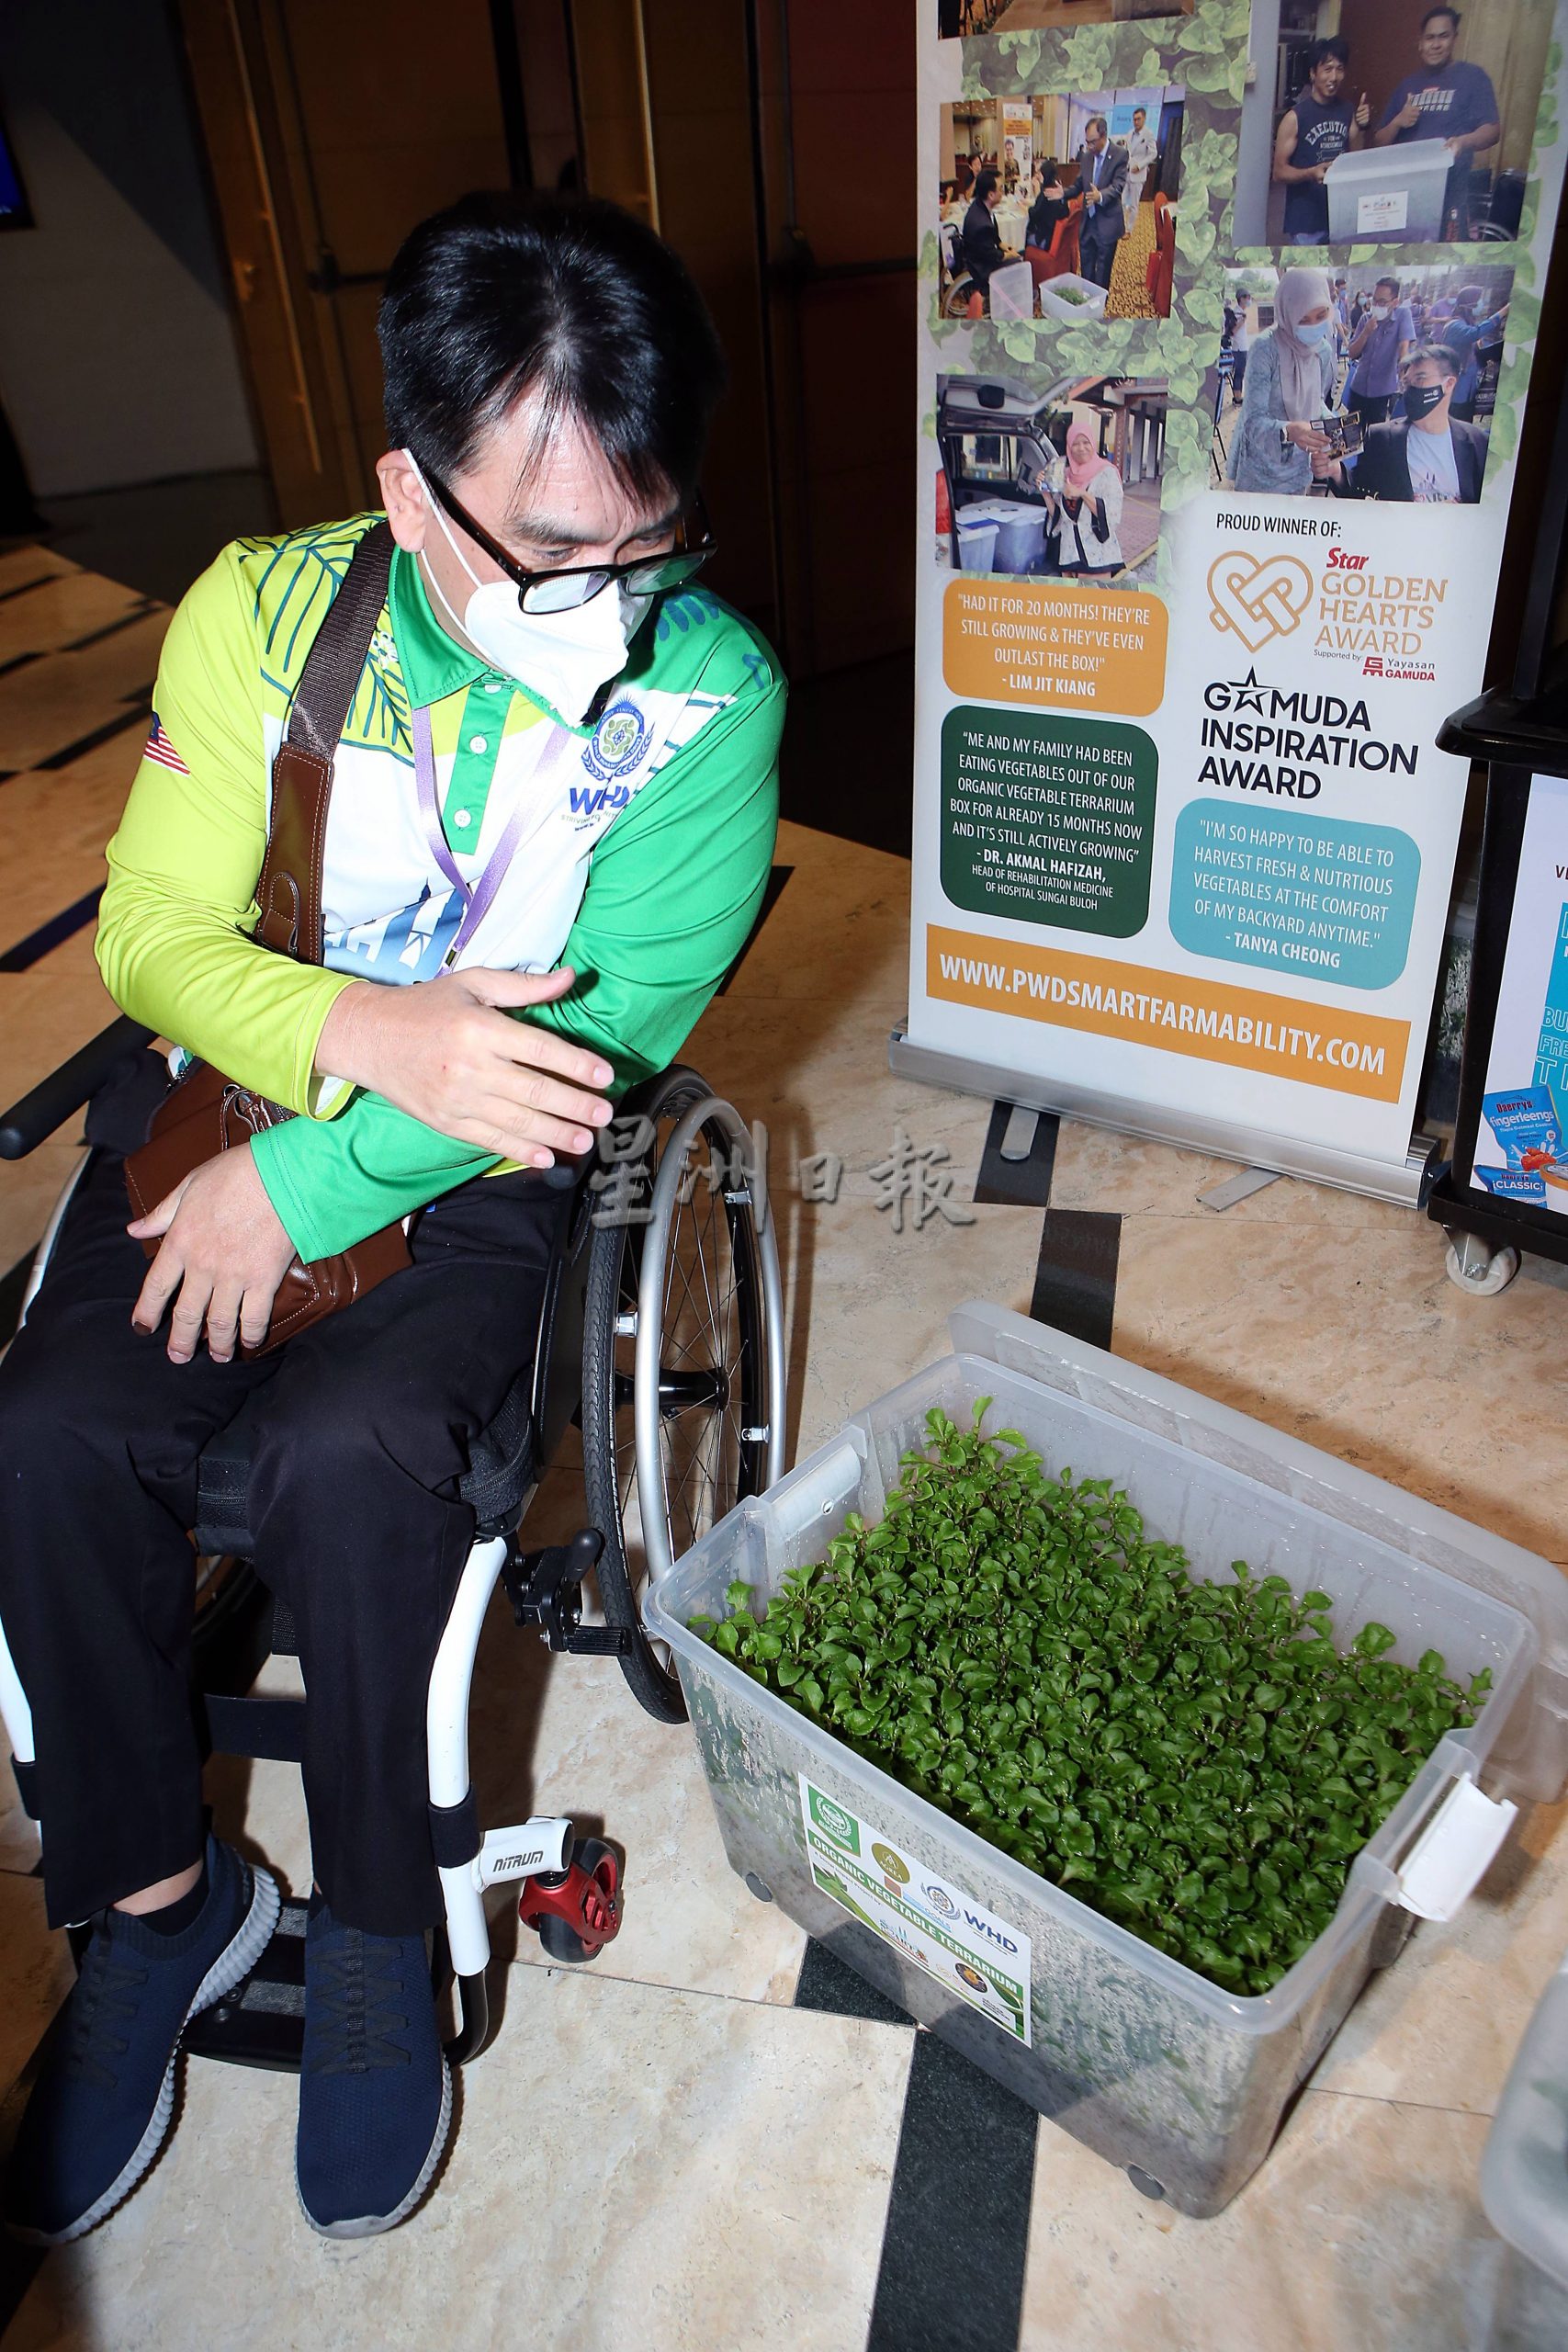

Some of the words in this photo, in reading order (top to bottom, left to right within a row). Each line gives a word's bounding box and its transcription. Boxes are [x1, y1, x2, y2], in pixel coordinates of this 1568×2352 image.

[1217, 514, 1260, 531] PROUD
[1264, 517, 1316, 536] WINNER
[1321, 521, 1342, 537] OF:
[1326, 548, 1370, 571] Star
[1321, 572, 1448, 603] GOLDEN
[988, 597, 998, 611] IT
[1001, 598, 1022, 615] FOR
[1027, 600, 1041, 616] 20
[1044, 602, 1099, 620] MONTHS!
[1319, 598, 1434, 629] HEARTS
[962, 619, 988, 637] STILL
[992, 623, 1046, 642] GROWING
[1050, 628, 1059, 642] &
[1113, 633, 1144, 650] EVEN
[1314, 626, 1422, 655] AWARD
[995, 648, 1044, 666] OUTLAST
[1047, 652, 1068, 669] THE
[1314, 650, 1350, 661] Supported
[1388, 659, 1435, 671] Yayasan
[1010, 674, 1032, 689] LIM
[1034, 677, 1052, 692] JIT
[1056, 679, 1095, 696] KIANG
[1385, 670, 1436, 681] GAMUDA
[987, 735, 1010, 751] AND
[1013, 738, 1031, 752] MY
[1033, 741, 1072, 759] FAMILY
[1076, 746, 1100, 762] HAD
[1103, 749, 1132, 766] BEEN
[1201, 718, 1418, 775] INSPIRATION
[959, 754, 996, 773] EATING
[998, 760, 1065, 782] VEGETABLES
[1068, 769, 1090, 785] OUT
[1094, 773, 1108, 786] OF
[1111, 775, 1134, 791] OUR
[1198, 756, 1321, 799] AWARD
[570, 786, 629, 815] WHD
[958, 777, 1004, 797] ORGANIC
[1006, 785, 1066, 806] VEGETABLE
[1069, 793, 1134, 815] TERRARIUM
[951, 798, 970, 814] BOX
[973, 802, 992, 818] FOR
[996, 807, 1043, 825] ALREADY
[1047, 814, 1060, 827] 15
[1064, 815, 1111, 835] MONTHS
[1114, 824, 1142, 840] NOW
[953, 821, 974, 837] AND
[998, 830, 1025, 845] STILL
[1028, 833, 1077, 855] ACTIVELY
[1229, 825, 1247, 842] SO
[1250, 828, 1294, 851] HAPPY
[1297, 836, 1313, 854] TO
[1317, 841, 1334, 858] BE
[1337, 844, 1371, 865] ABLE
[1377, 849, 1394, 866] TO
[972, 865, 993, 877] HEAD
[996, 869, 1006, 879] OF
[1008, 871, 1071, 890] REHABILITATION
[1074, 882, 1113, 898] MEDICINE
[984, 849, 1003, 865] DR.
[1006, 853, 1047, 871] AKMAL
[1050, 860, 1106, 883] HAFIZAH,
[1194, 846, 1253, 870] HARVEST
[1256, 857, 1296, 879] FRESH
[1300, 865, 1310, 881] &
[1314, 867, 1393, 896] NUTRTIOUS
[986, 881, 996, 892] OF
[998, 884, 1035, 899] HOSPITAL
[1037, 891, 1067, 905] SUNGAI
[1070, 897, 1098, 910] BULOH
[1193, 872, 1271, 900] VEGETABLES
[1275, 888, 1291, 904] AT
[1294, 891, 1318, 910] THE
[1322, 897, 1389, 922] COMFORT
[1195, 899, 1211, 915] OF
[1214, 903, 1235, 920] MY
[1238, 907, 1304, 934] BACKYARD
[1235, 933, 1278, 955] TANYA
[1281, 943, 1340, 968] CHEONG
[939, 954, 1386, 1075] WWW.PWDSMARTFARMABILITY.COM
[1542, 1006, 1568, 1034] BU
[1489, 1111, 1554, 1126] fingerleengs
[814, 1838, 866, 1884] ORGANIC
[868, 1879, 937, 1939] VEGETABLE
[938, 1933, 1018, 1993] TERRARIUM
[964, 1909, 1018, 1953] WHD
